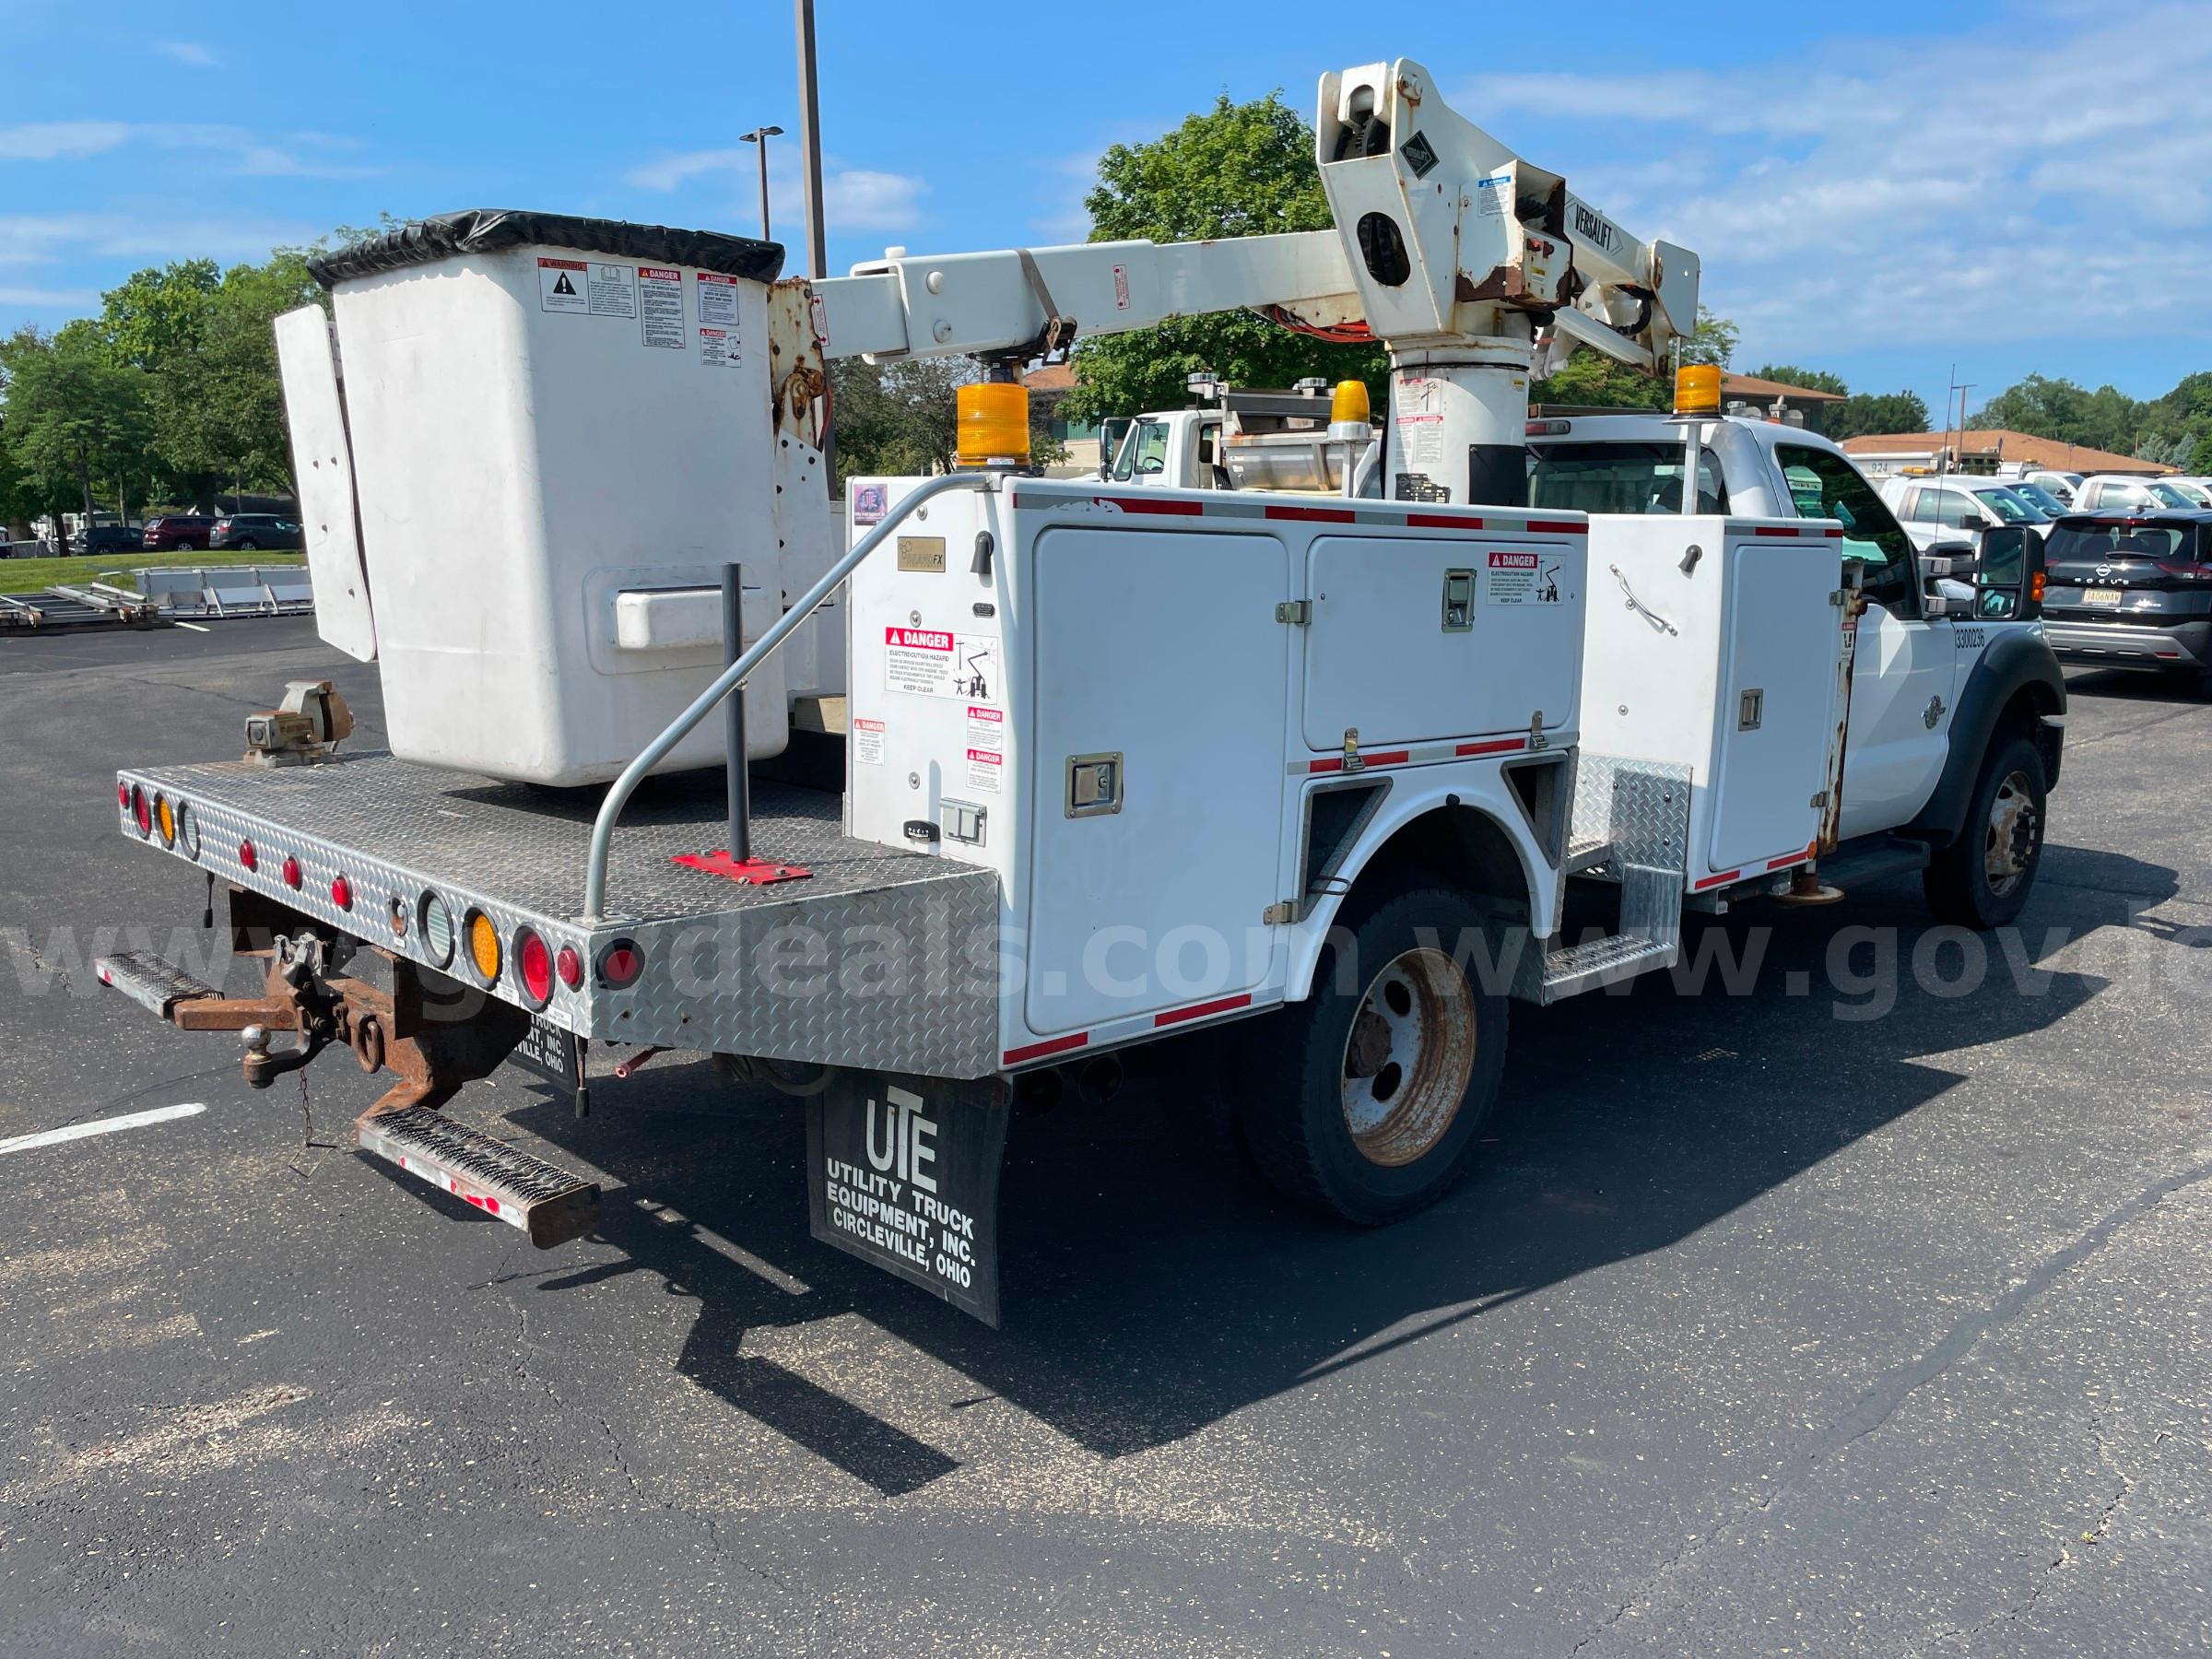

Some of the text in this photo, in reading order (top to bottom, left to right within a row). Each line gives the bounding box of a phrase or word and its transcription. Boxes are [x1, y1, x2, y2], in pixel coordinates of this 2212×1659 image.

[1575, 203, 1612, 252] VERSALIFT
[649, 270, 678, 280] DANGER
[1871, 463, 1888, 473] 924
[1502, 555, 1535, 567] DANGER
[903, 631, 949, 649] DANGER
[1956, 628, 1985, 649] 3300236
[888, 650, 949, 663] ELECTROCUTION HAZARD
[976, 709, 1001, 721] DANGER
[862, 722, 885, 731] DANGER
[975, 752, 1000, 763] DANGER
[547, 1034, 565, 1057] INC.
[545, 1051, 564, 1074] OHIO
[866, 1085, 937, 1194] UTE
[827, 1157, 974, 1240] UTILITY TRUCK
[827, 1181, 976, 1267] EQUIPMENT, INC.
[833, 1207, 971, 1288] CIRCLEVILLE, OHIO
